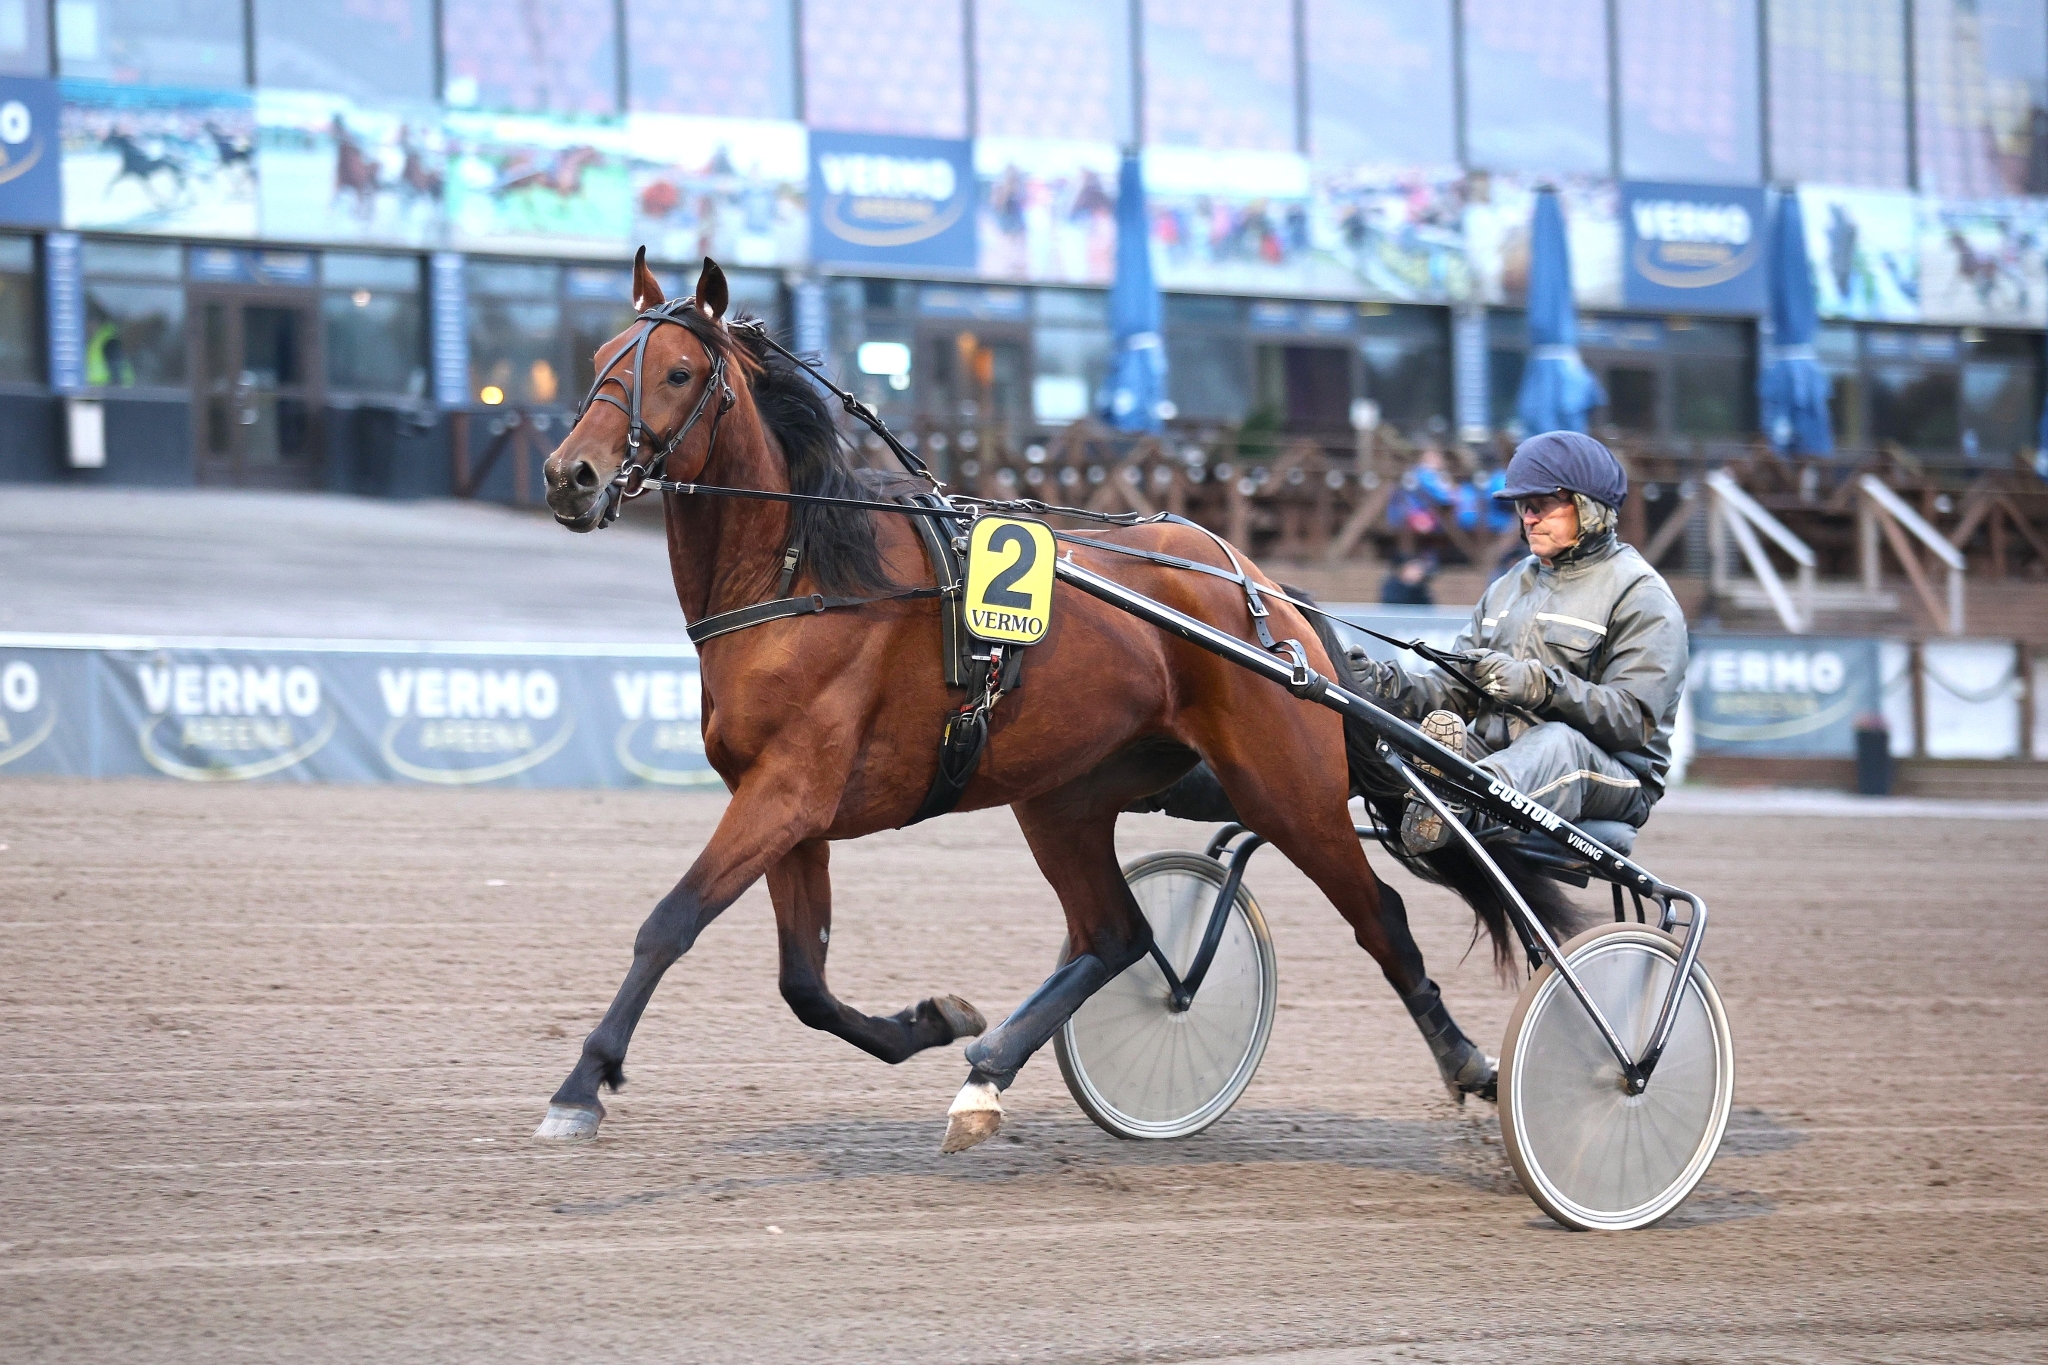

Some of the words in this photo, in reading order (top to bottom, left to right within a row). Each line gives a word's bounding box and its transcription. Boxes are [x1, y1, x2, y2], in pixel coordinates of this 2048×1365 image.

[982, 523, 1037, 611] 2
[972, 609, 1043, 635] VERMO
[138, 664, 320, 717] VERMO
[378, 667, 559, 719] VERMO
[613, 670, 702, 720] VER
[1488, 780, 1563, 832] CUSTOM
[1567, 832, 1604, 861] VIKING
